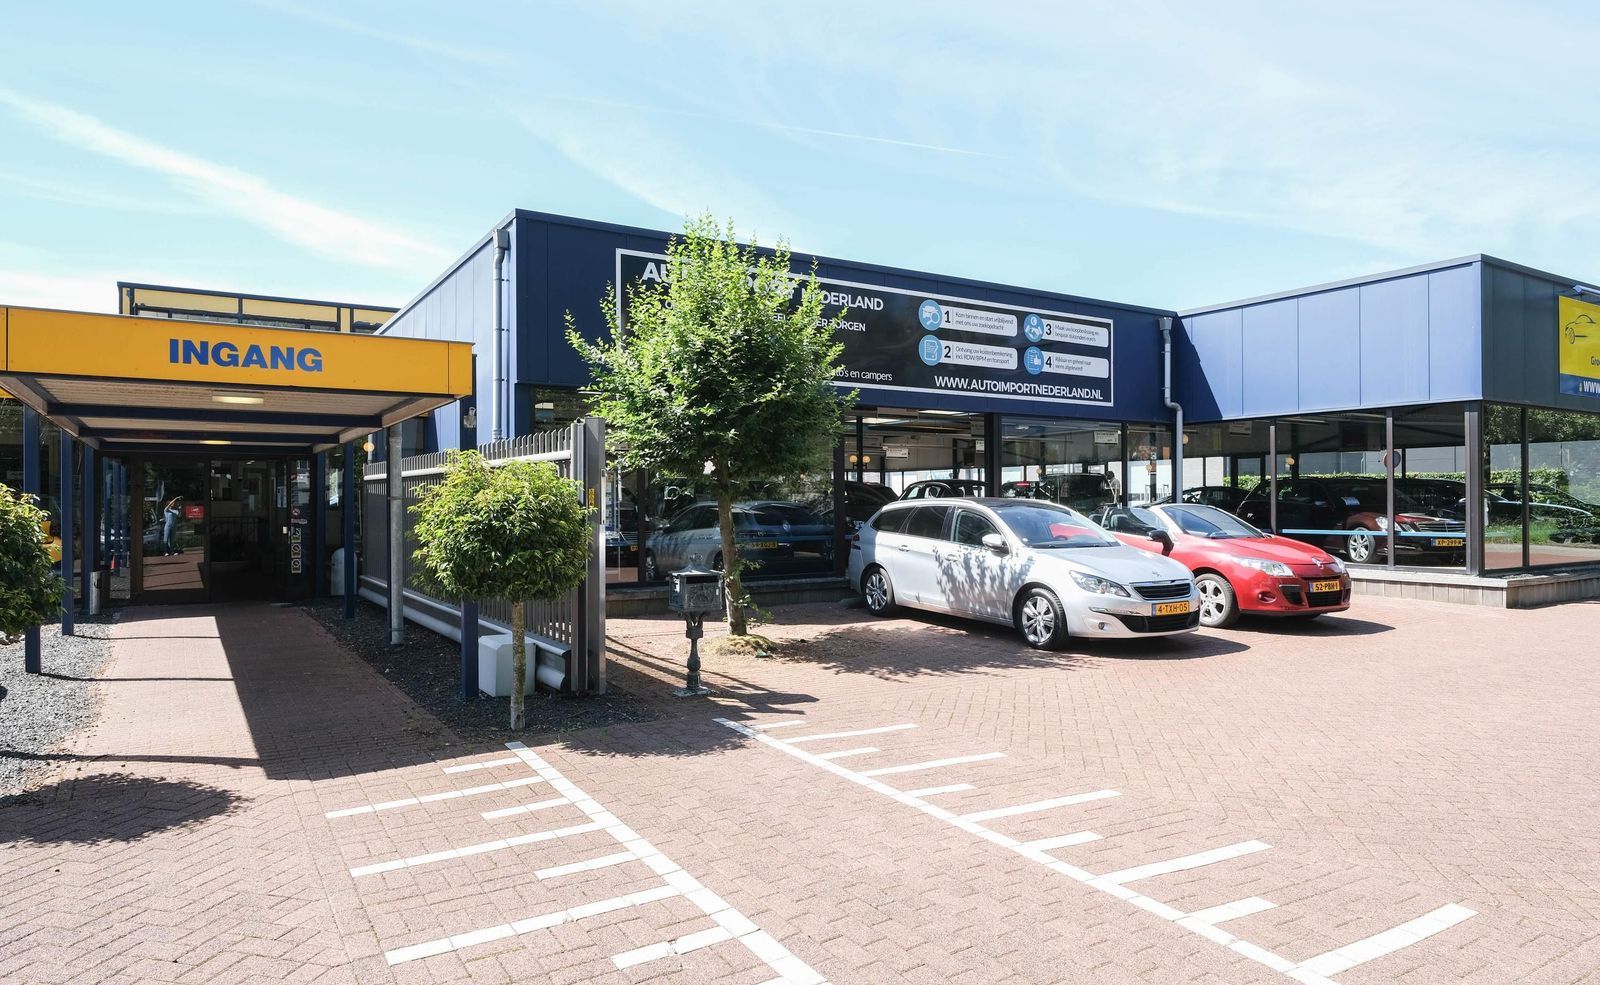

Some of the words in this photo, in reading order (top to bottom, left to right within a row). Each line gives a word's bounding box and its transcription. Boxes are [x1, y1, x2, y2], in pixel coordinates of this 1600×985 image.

[944, 310, 951, 324] 1
[1045, 323, 1052, 335] 3
[169, 338, 323, 372] INGANG
[944, 345, 951, 359] 2
[1045, 356, 1052, 368] 4
[850, 370, 860, 379] en
[861, 371, 893, 382] campers
[934, 375, 1103, 400] WWW.AUTOIMPORTNEDERLAND.NL
[1157, 603, 1188, 614] 4-TXH-05
